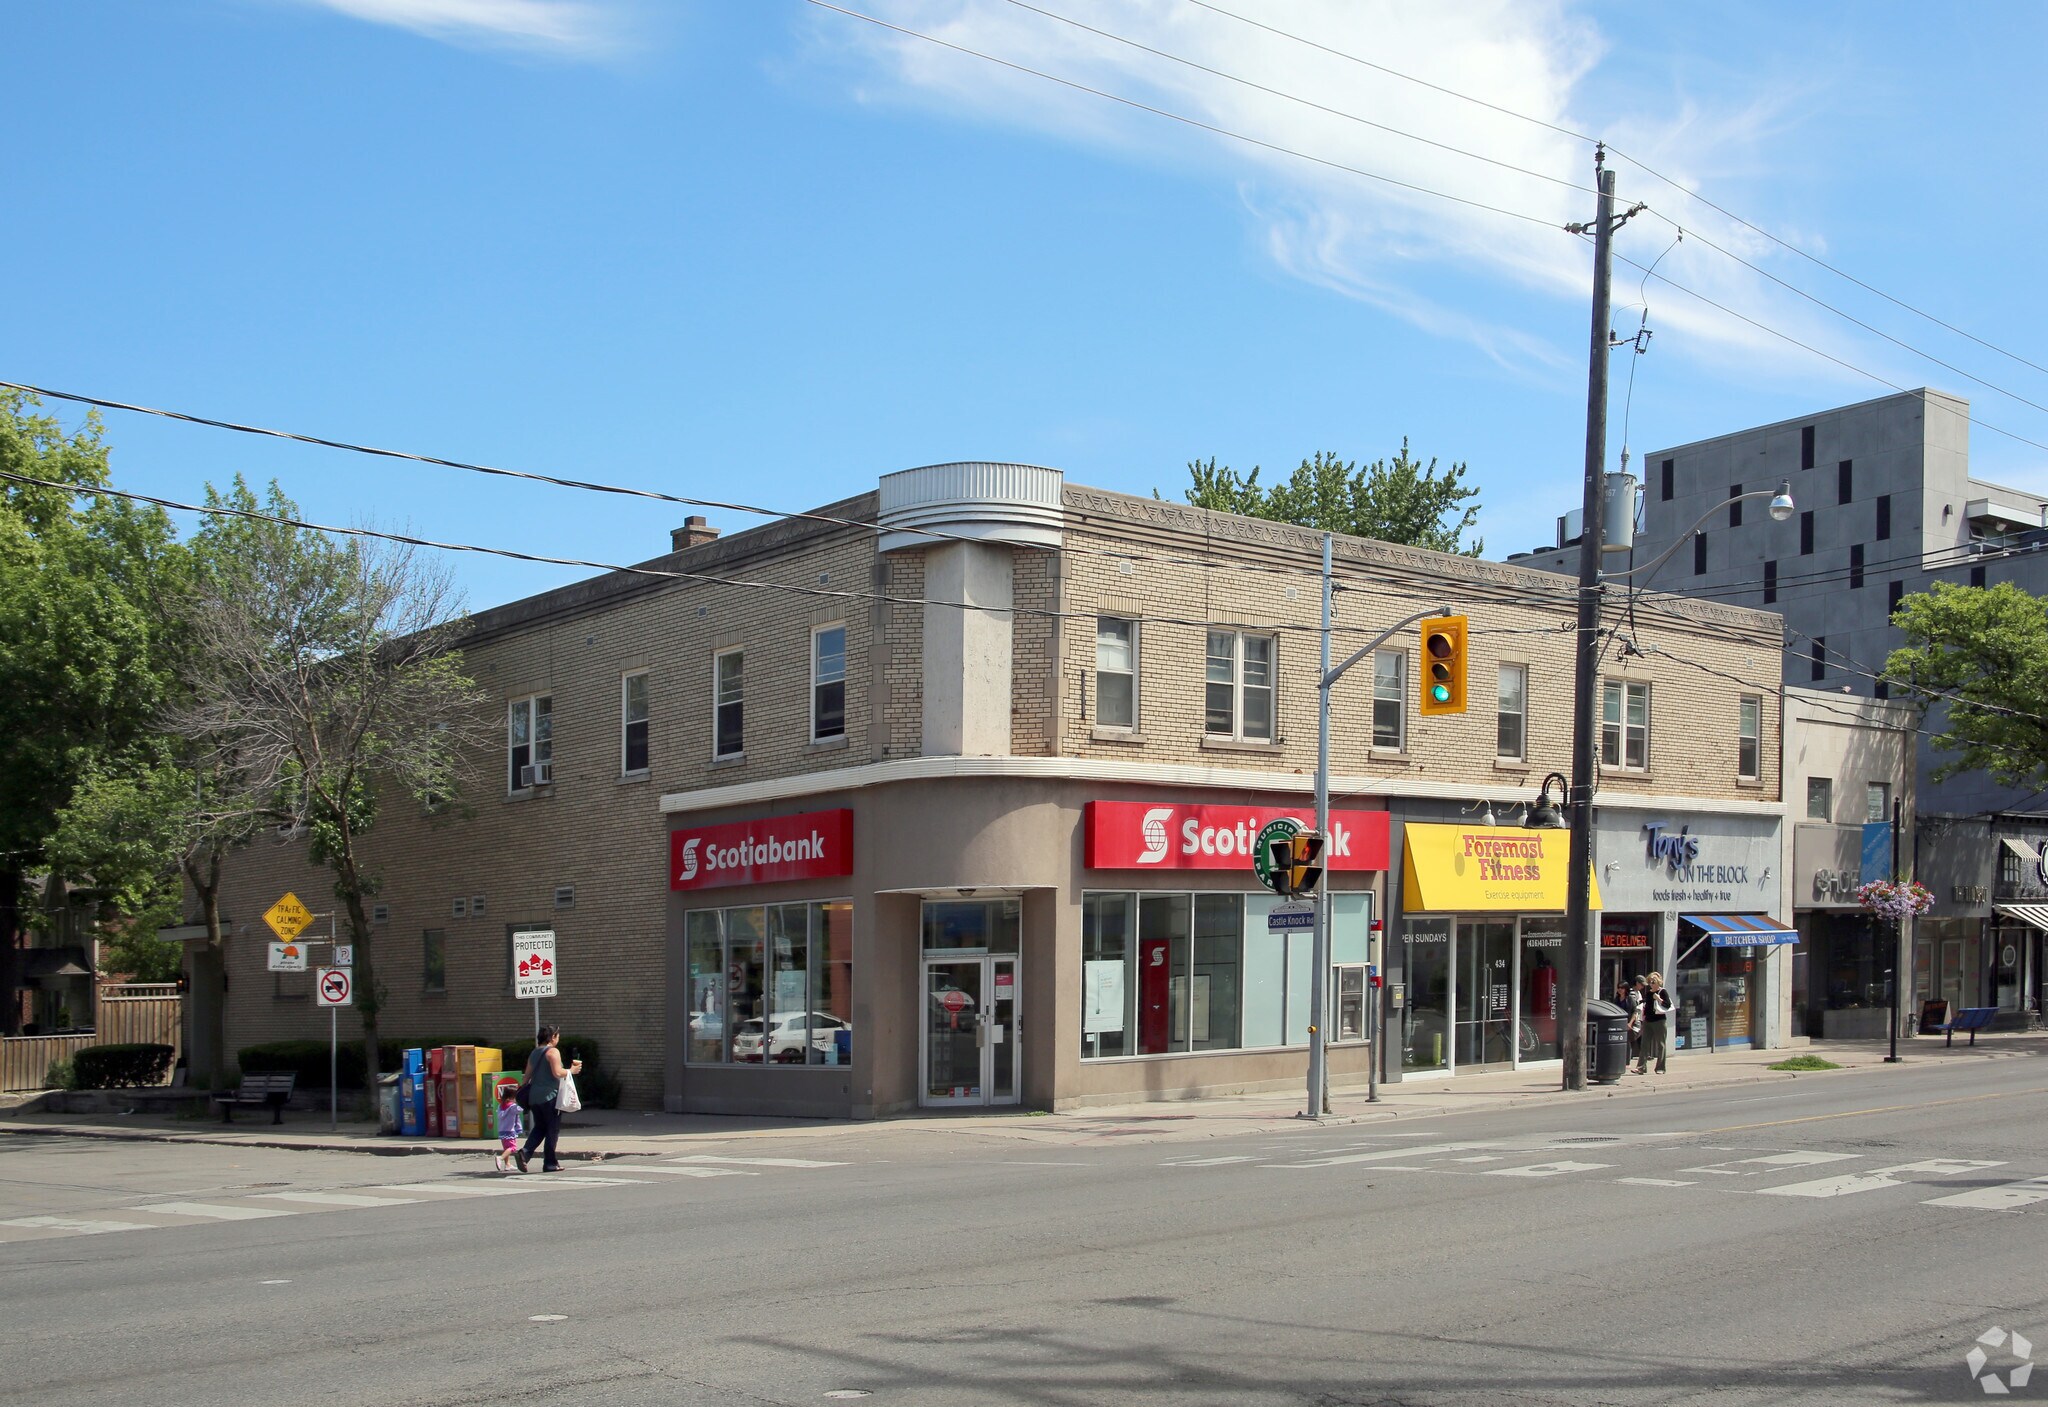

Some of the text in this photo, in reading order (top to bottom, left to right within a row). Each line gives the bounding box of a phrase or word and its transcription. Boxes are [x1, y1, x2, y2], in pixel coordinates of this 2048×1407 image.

[1256, 823, 1294, 849] MUNICIP
[705, 830, 825, 871] Scotiabank
[1463, 833, 1544, 859] Foremost
[1645, 821, 1699, 870] Tony's
[1478, 858, 1541, 881] Fitness
[1677, 865, 1749, 884] ON THE BLOCK
[1485, 890, 1545, 902] Exercise equipment
[1652, 889, 1671, 902] foods
[1671, 889, 1687, 902] fresh
[1692, 889, 1714, 903] healthy
[276, 916, 303, 925] CALMING
[1269, 915, 1314, 926] Castle Knock Rd
[280, 926, 296, 936] ZONE
[1415, 933, 1447, 943] SUNDAYS
[1603, 935, 1647, 946] WE DELIVER
[1725, 935, 1758, 945] BUTCHER
[1758, 934, 1776, 944] SHOP
[515, 940, 554, 950] PROTECTED
[1495, 959, 1506, 968] 434
[520, 985, 552, 995] WATCH
